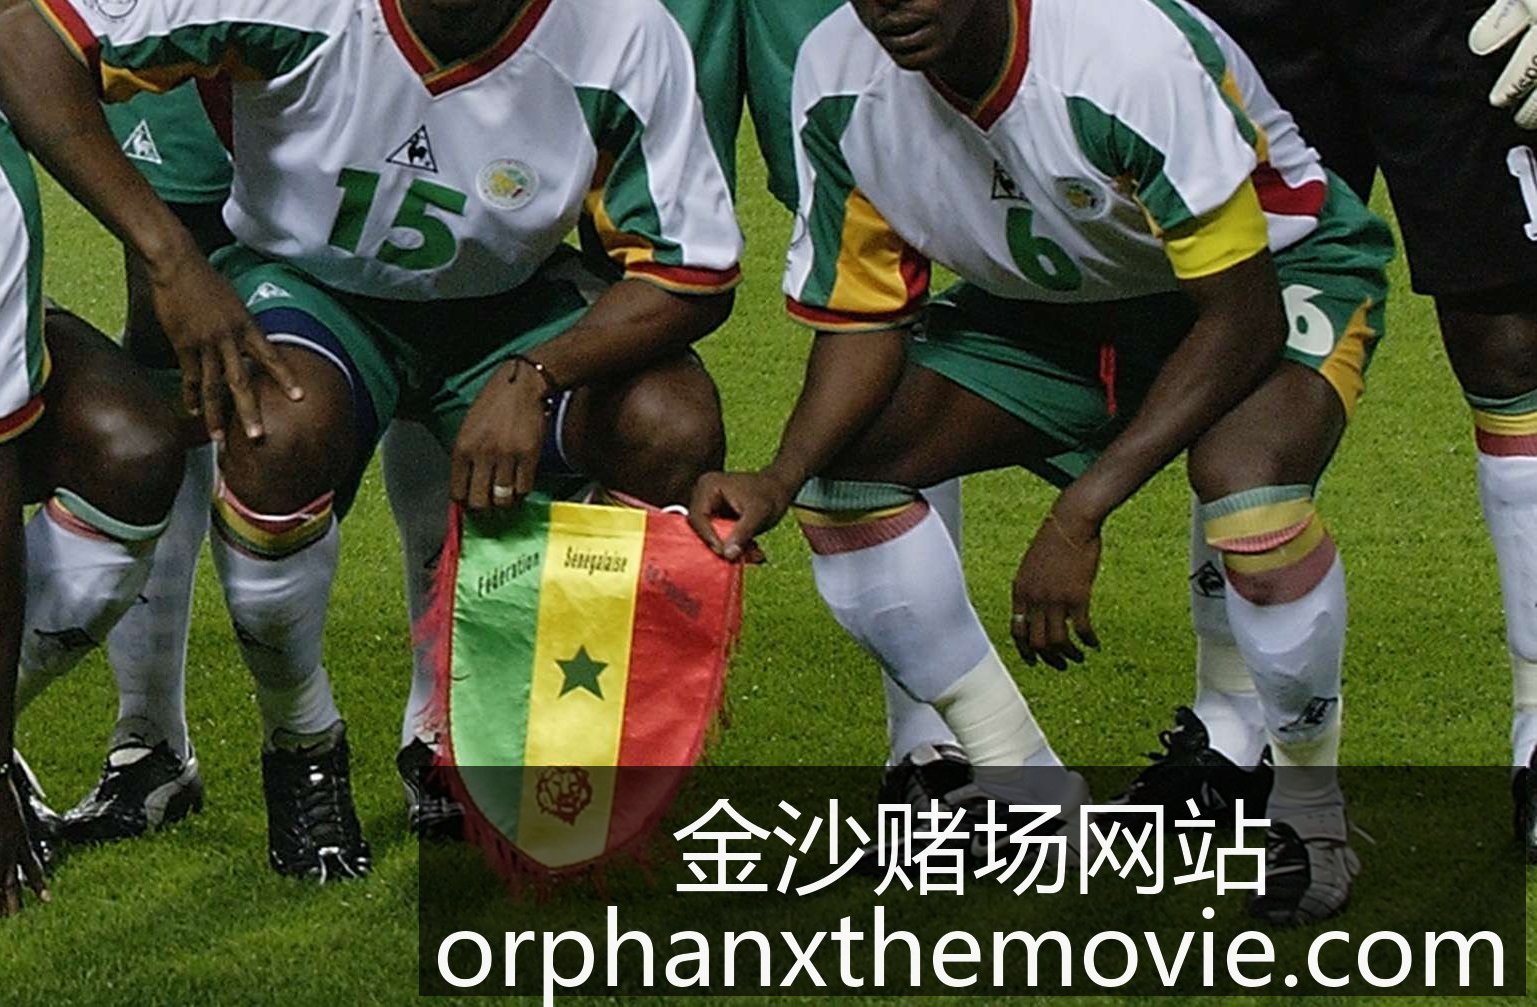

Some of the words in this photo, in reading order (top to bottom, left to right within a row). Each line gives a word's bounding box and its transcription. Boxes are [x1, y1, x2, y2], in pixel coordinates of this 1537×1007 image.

[328, 167, 468, 271] 15
[1006, 207, 1083, 291] 6
[1281, 283, 1332, 357] 6
